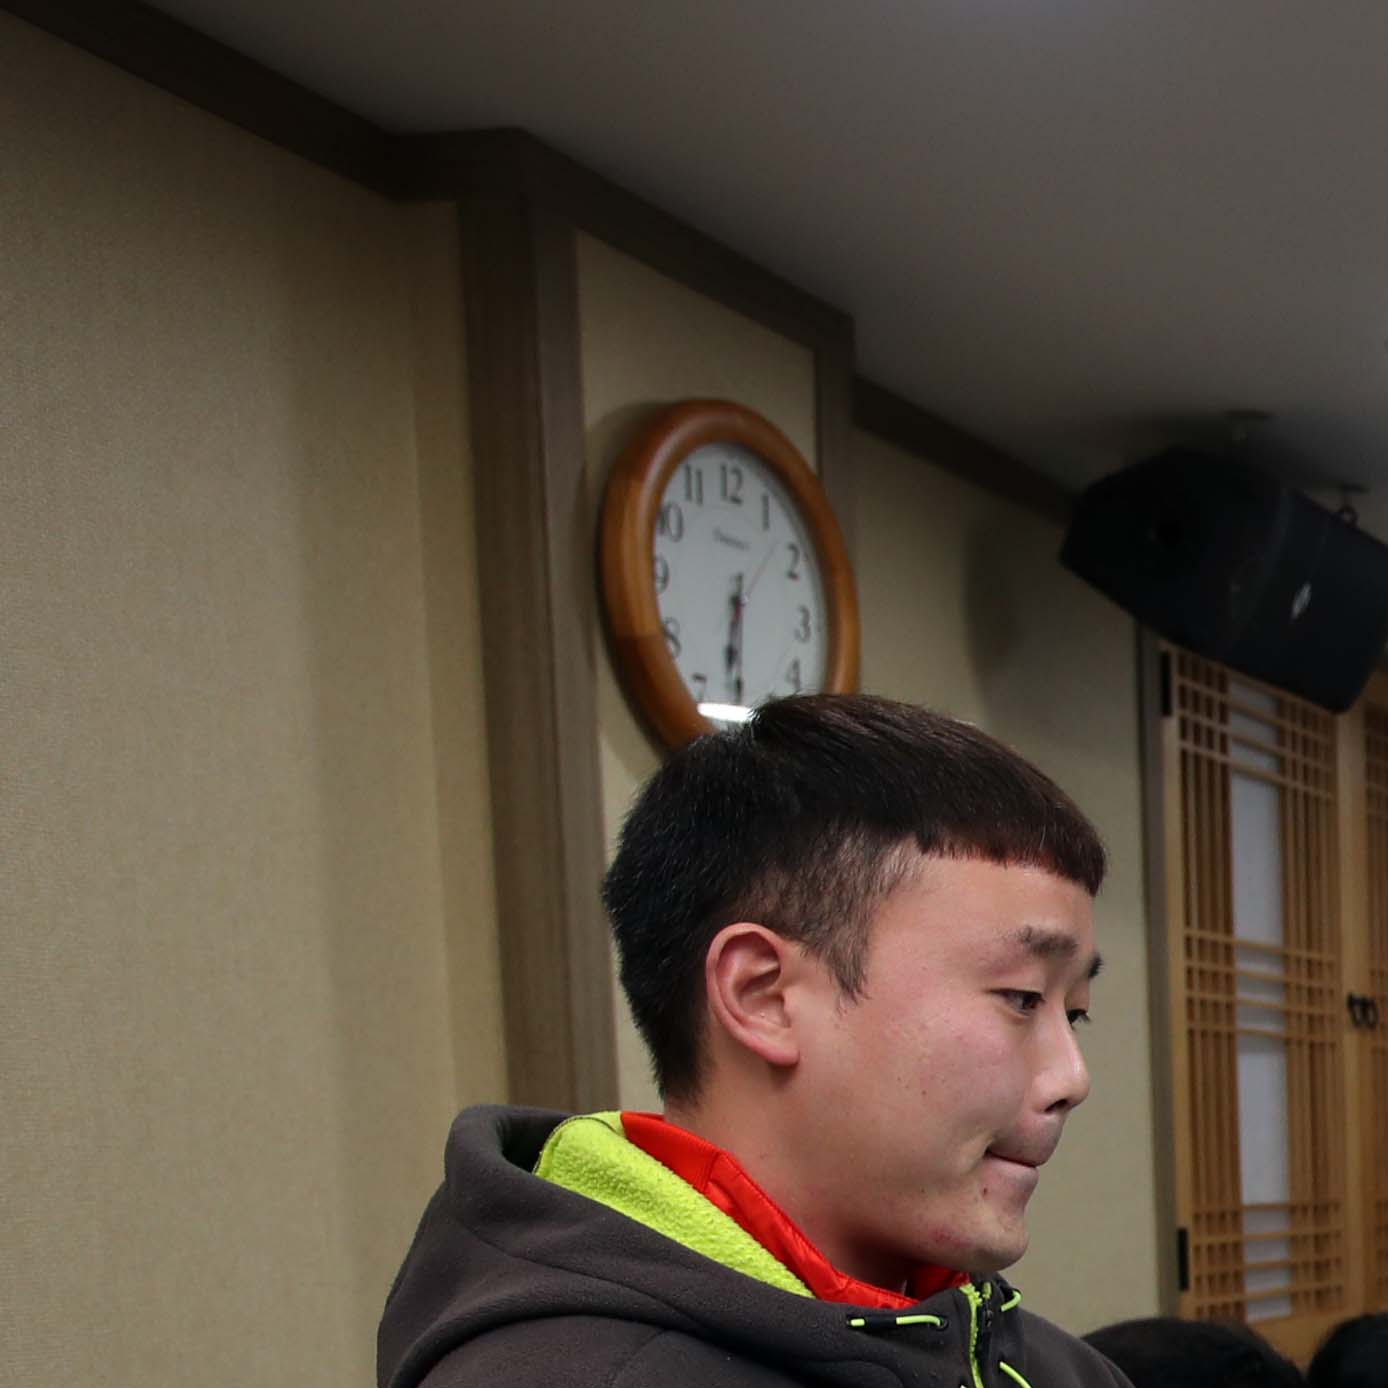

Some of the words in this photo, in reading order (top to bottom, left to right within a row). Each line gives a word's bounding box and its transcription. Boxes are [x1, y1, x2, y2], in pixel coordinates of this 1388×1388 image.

[684, 464, 704, 505] 11
[720, 464, 744, 504] 12
[655, 558, 669, 593] 9
[786, 544, 801, 580] 2
[795, 606, 811, 643] 3
